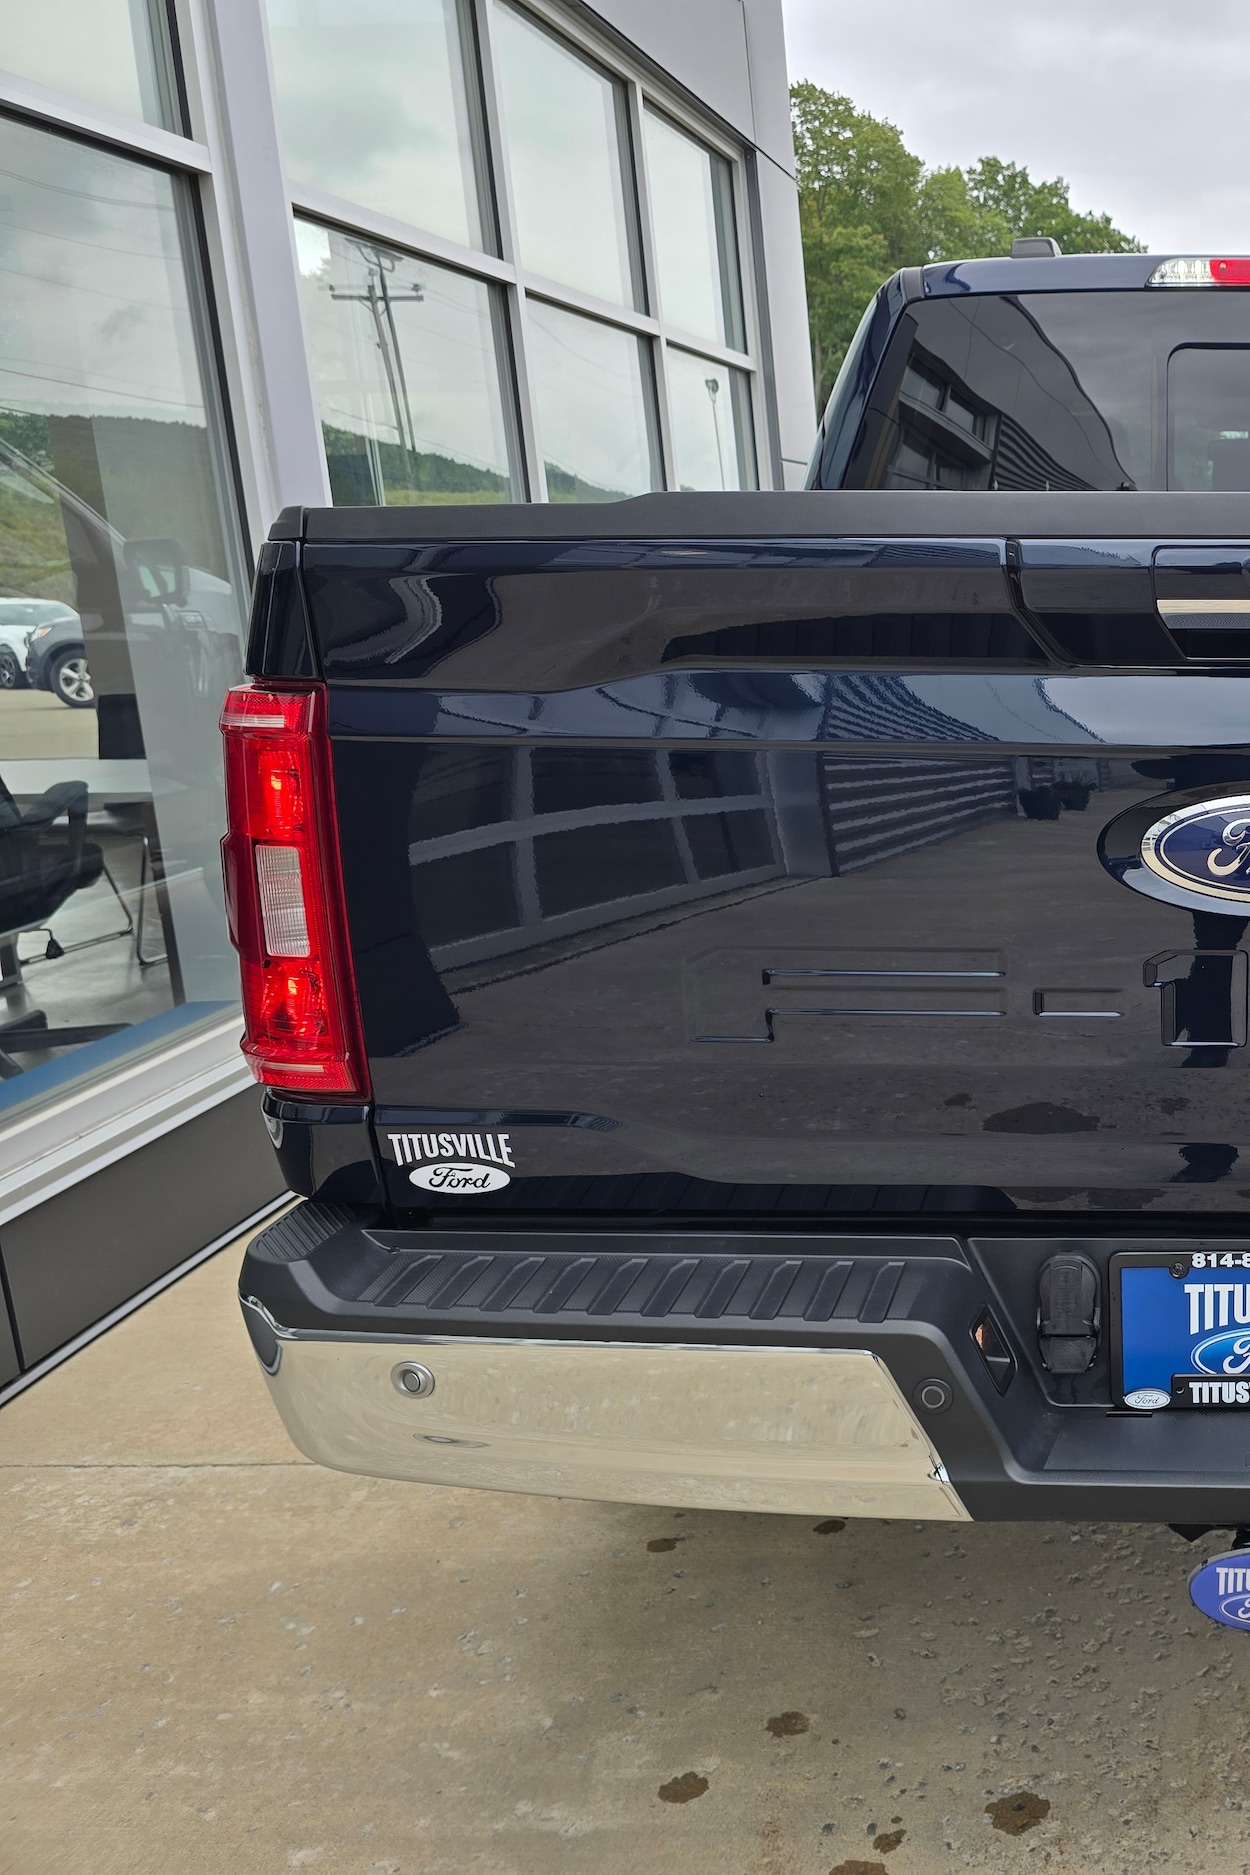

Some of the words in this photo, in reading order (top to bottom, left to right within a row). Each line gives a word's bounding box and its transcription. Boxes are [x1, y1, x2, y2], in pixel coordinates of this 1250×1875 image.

[387, 1133, 516, 1168] TITUSVILLE
[428, 1167, 491, 1188] Ford
[1134, 1394, 1160, 1405] Ford
